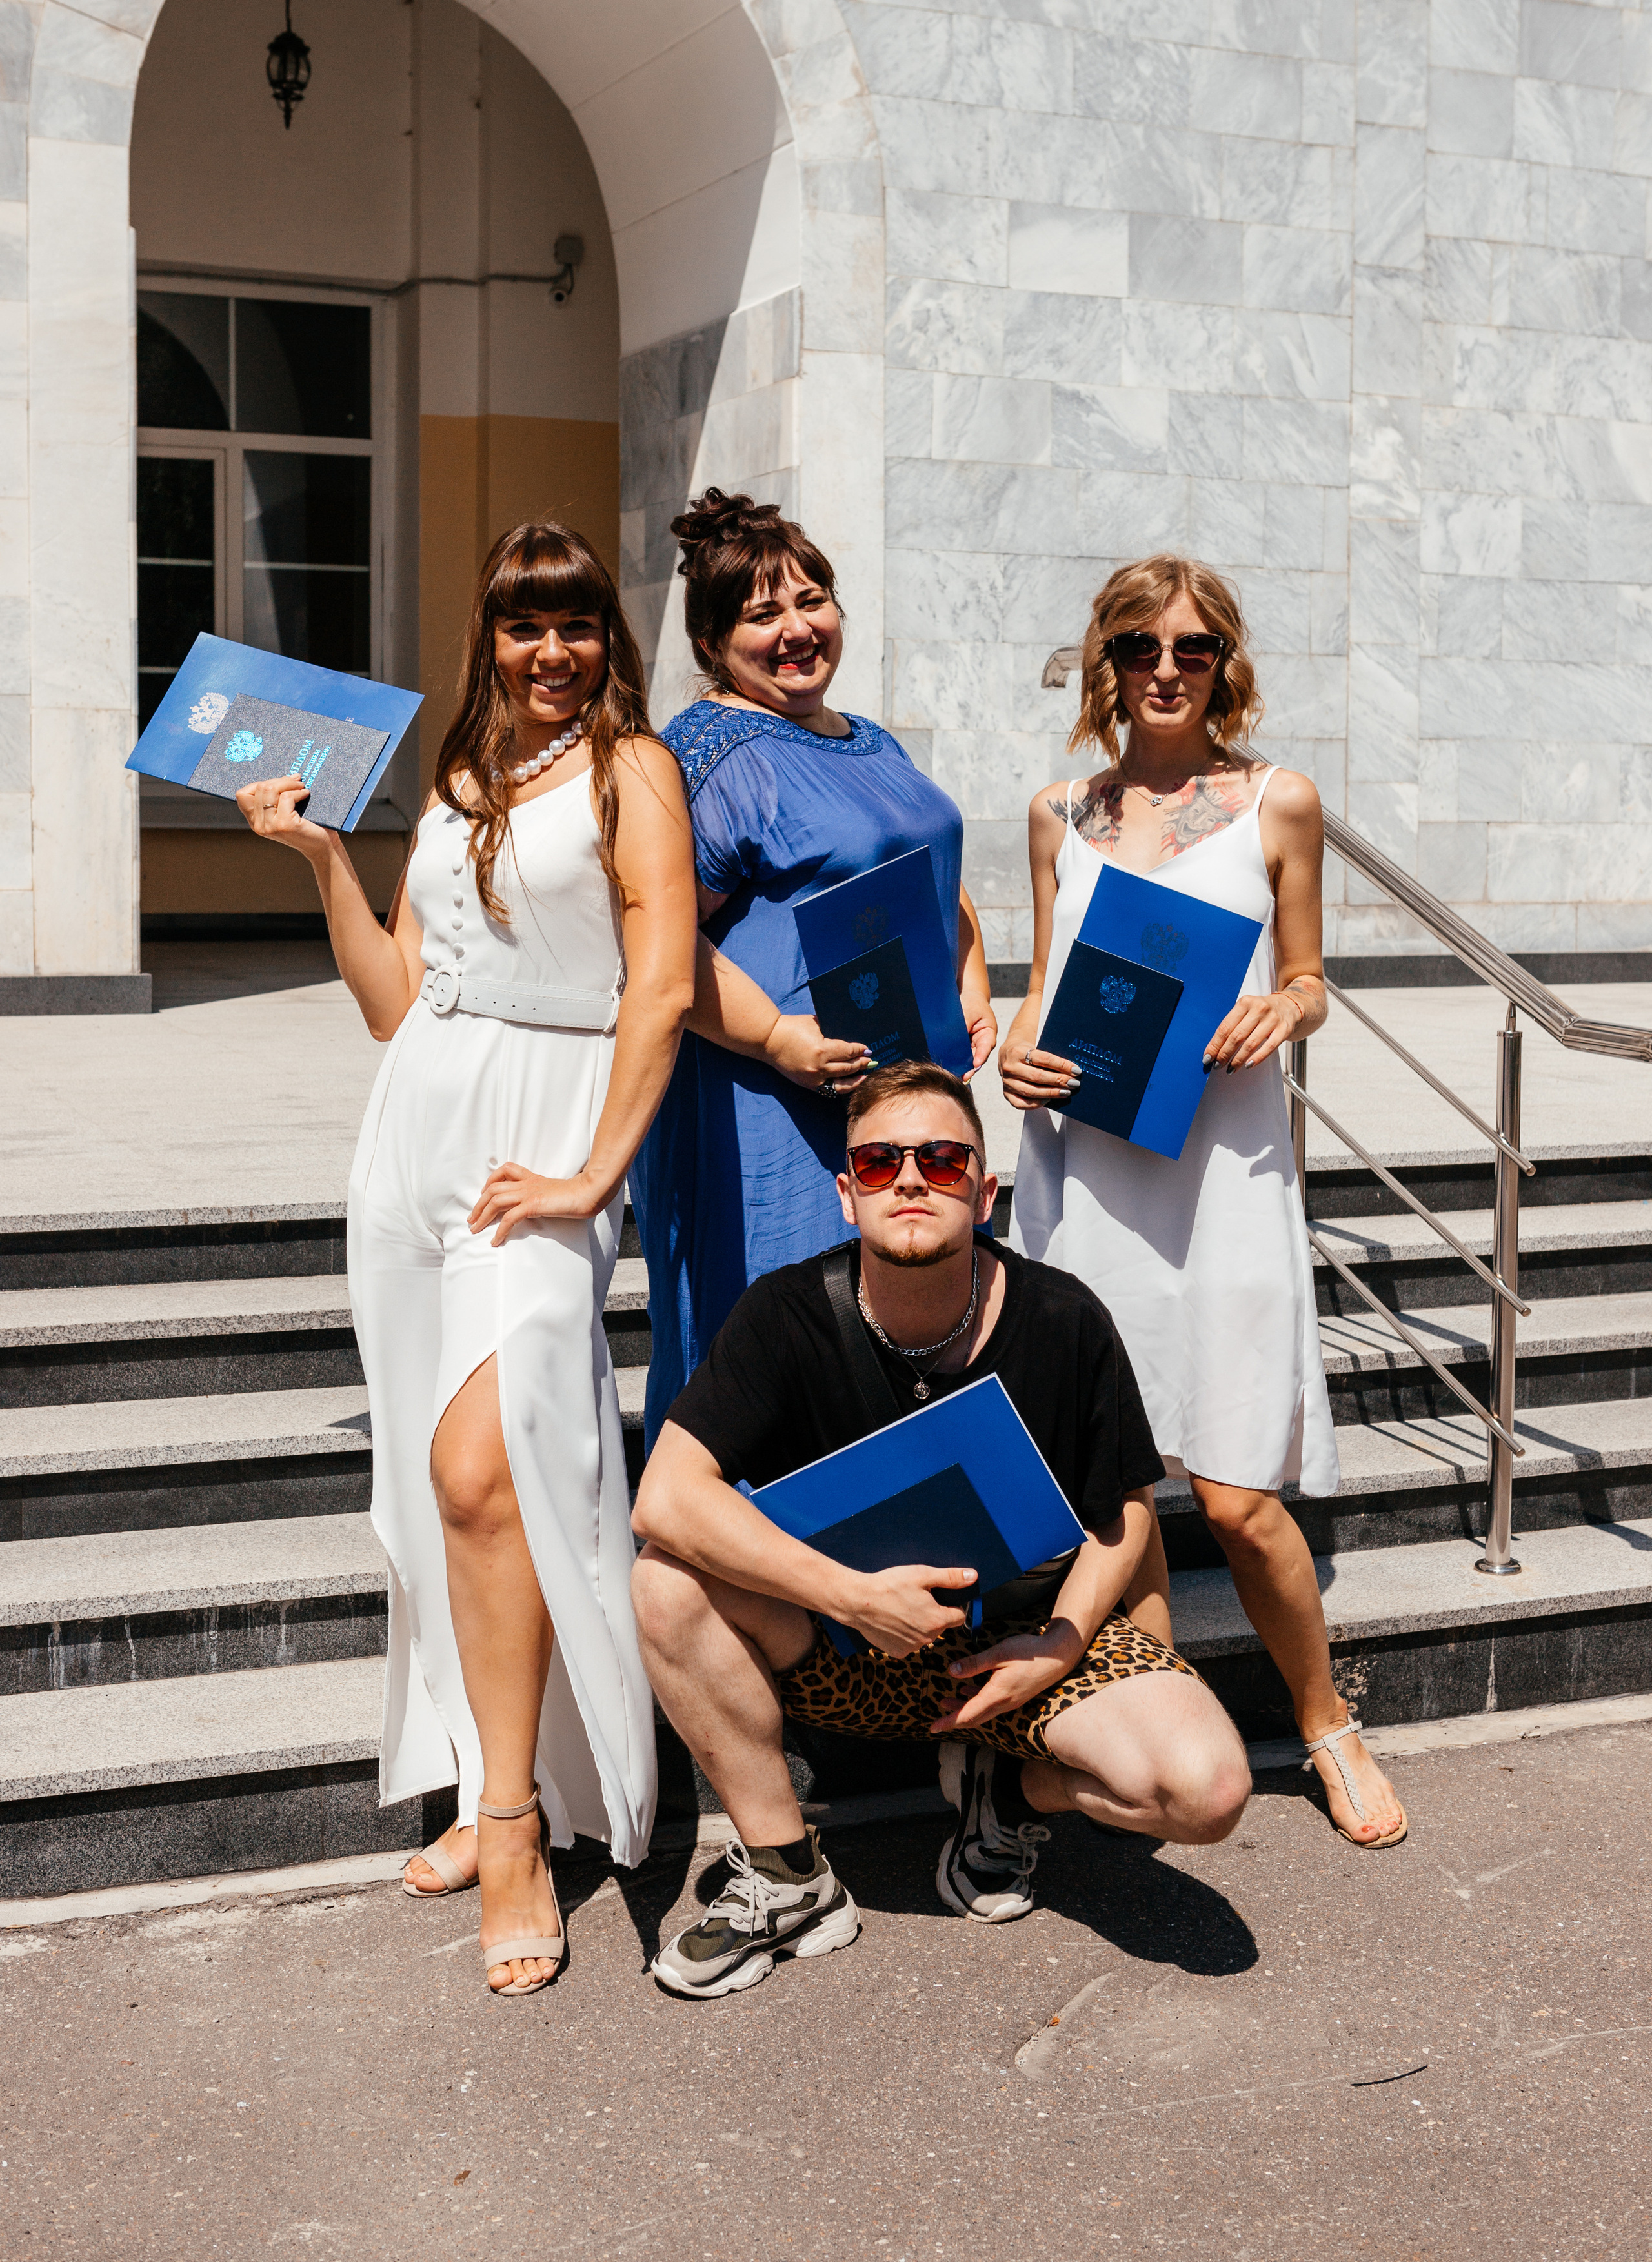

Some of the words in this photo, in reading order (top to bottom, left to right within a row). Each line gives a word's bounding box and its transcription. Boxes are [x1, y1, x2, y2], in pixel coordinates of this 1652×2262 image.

[286, 739, 315, 777] ИПЛОМ
[303, 749, 321, 777] ВЫСШЕМ
[305, 745, 332, 789] ОБРАЗОВАНИИ
[868, 1031, 900, 1052] ПЛОМ
[1069, 1038, 1123, 1065] ДИПЛОМ
[1080, 1055, 1111, 1073] ВЫСШЕМ
